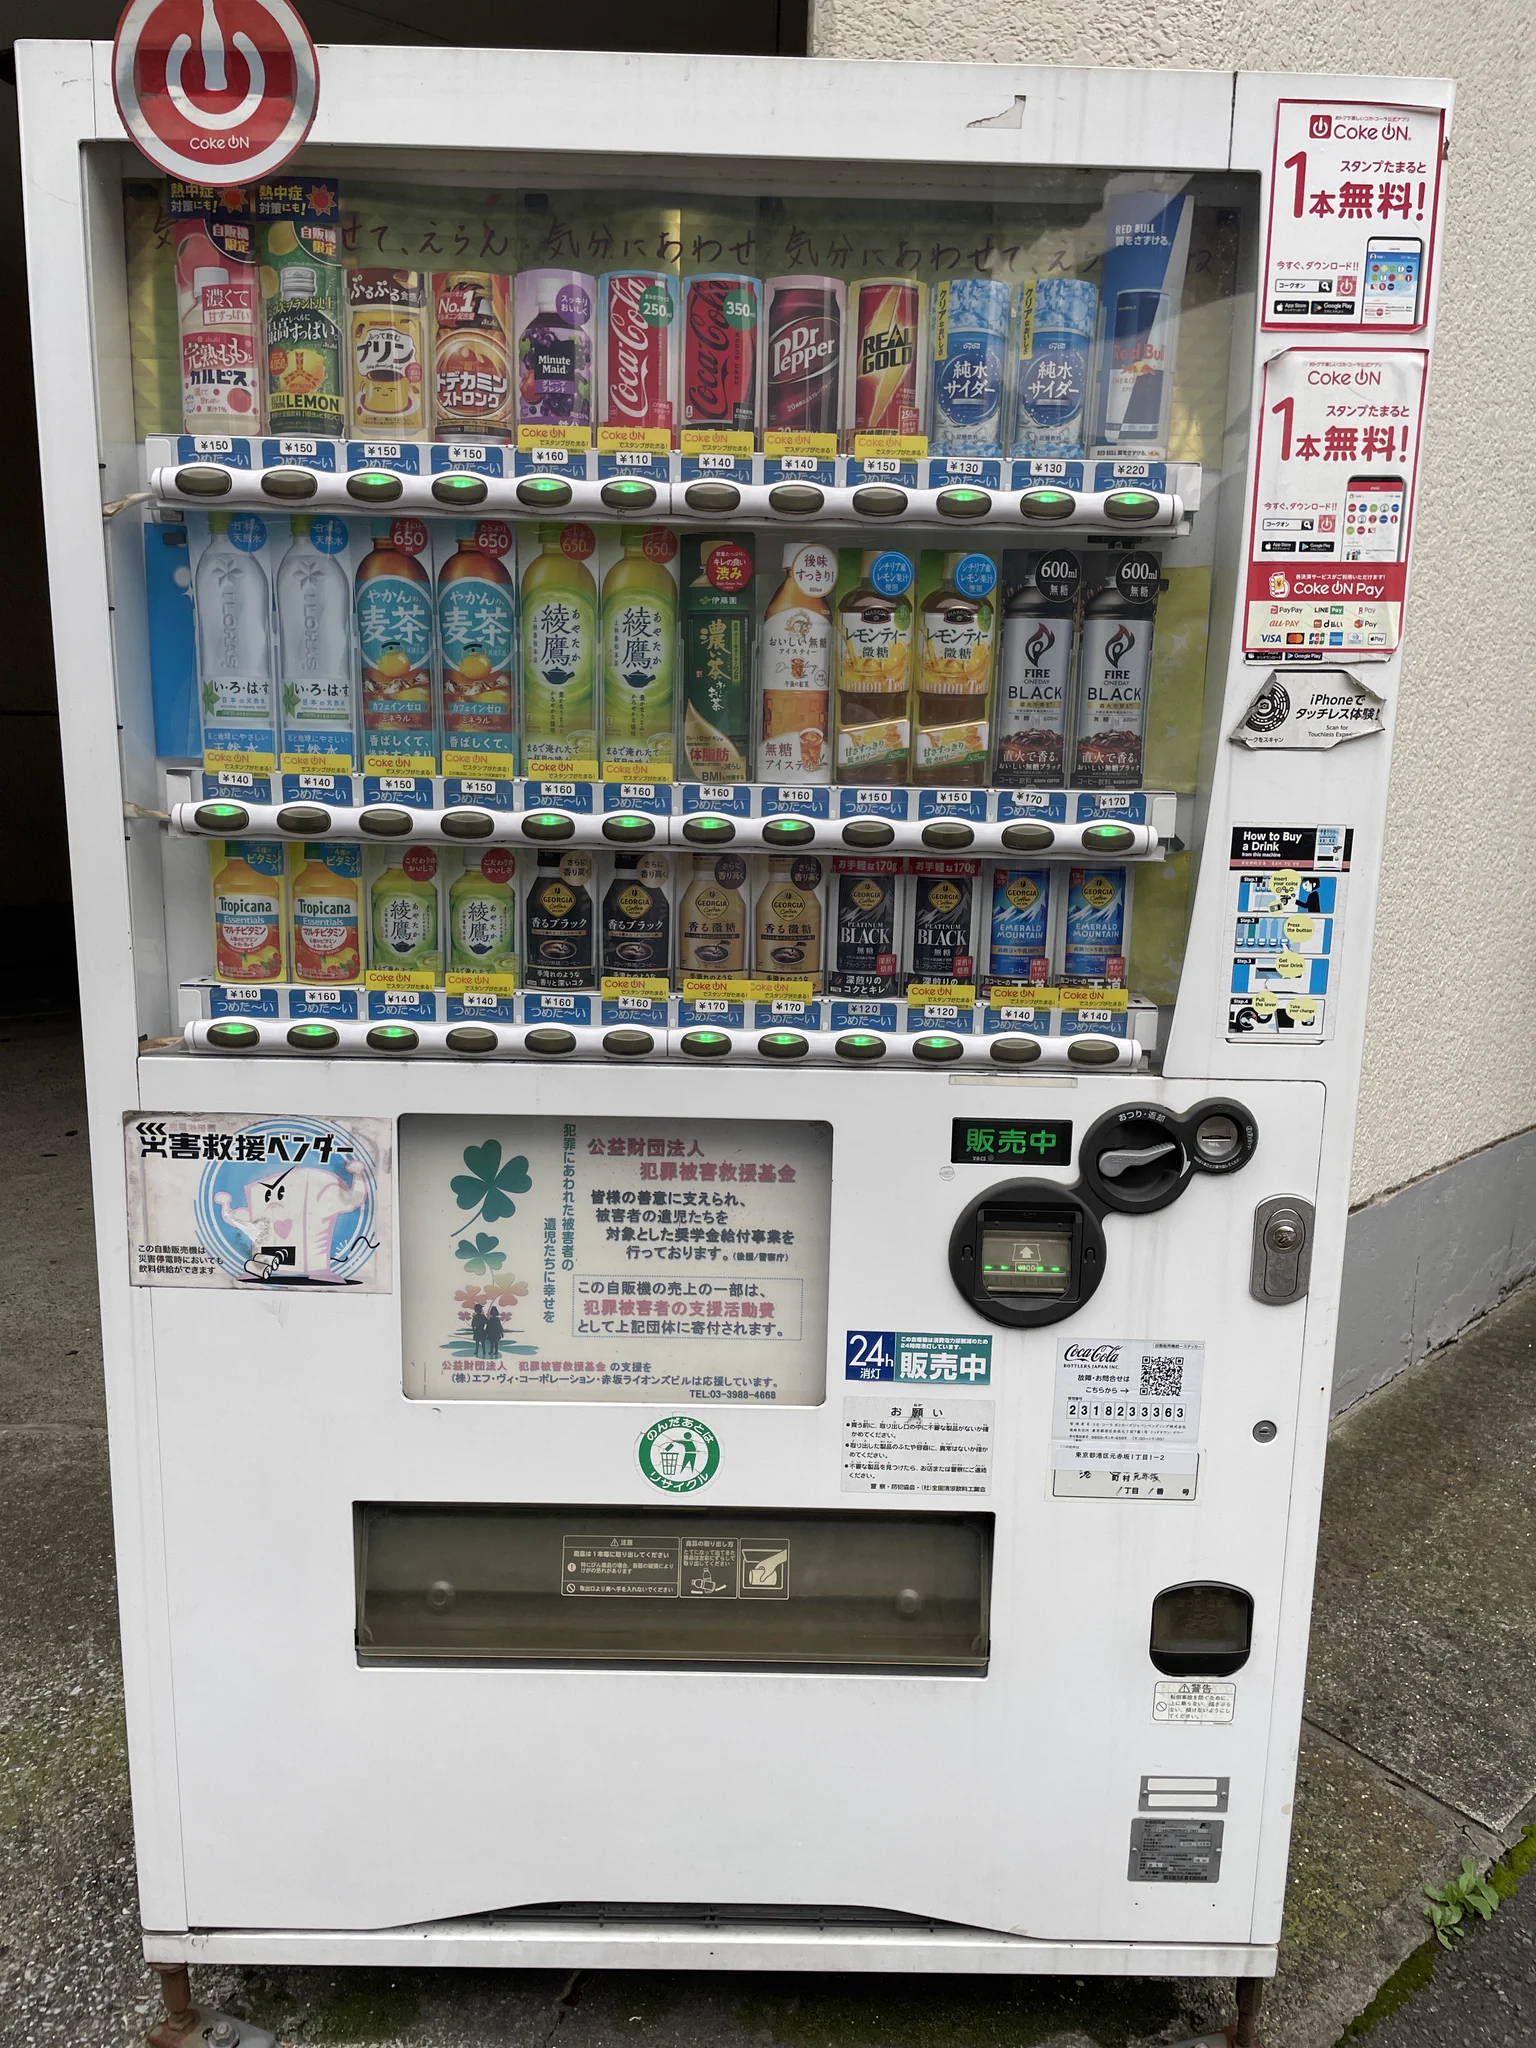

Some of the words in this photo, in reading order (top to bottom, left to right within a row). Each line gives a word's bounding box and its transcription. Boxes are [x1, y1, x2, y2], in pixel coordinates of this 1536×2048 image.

[1334, 125, 1378, 140] Coke
[190, 137, 225, 150] Coke
[1341, 160, 1427, 174] スタンプたまると
[259, 185, 303, 200] 熱中症
[212, 224, 249, 240] 自販機
[300, 225, 336, 243] 自販機
[1115, 224, 1132, 235] RED
[1134, 224, 1155, 234] BULL
[224, 240, 250, 254] 限定
[312, 240, 336, 256] 限定
[206, 288, 249, 308] 濃くて
[792, 326, 820, 345] Dr
[863, 324, 912, 352] REAL
[357, 340, 415, 364] プリン
[773, 338, 836, 377] Pepper
[538, 354, 571, 366] Minute
[862, 349, 913, 375] GOLD
[542, 364, 567, 375] Maid
[953, 361, 988, 378] 純水
[1037, 361, 1072, 378] 純水
[190, 370, 249, 387] カルピス
[437, 373, 508, 392] ドデカミン
[1307, 370, 1351, 386] Coke
[943, 380, 995, 399] サイダー
[1028, 381, 1079, 400] サイダー
[286, 395, 339, 410] LEMON
[1325, 405, 1410, 418] スタンプたまると
[521, 428, 548, 438] Coke
[200, 441, 228, 450] ¥150
[368, 447, 397, 456] ¥150
[453, 449, 482, 458] ¥150
[620, 455, 648, 464] ¥110
[702, 458, 731, 467] ¥140
[867, 462, 896, 471] ¥150
[950, 463, 978, 473] ¥130
[1117, 466, 1145, 475] ¥220
[393, 532, 424, 546] 650
[478, 533, 509, 548] 650
[804, 554, 828, 568] 後味
[716, 566, 743, 580] 渋み
[1041, 562, 1078, 579] 600ml
[1121, 563, 1158, 580] 600ml
[1129, 585, 1149, 598] 無糖
[1293, 582, 1330, 595] Coke
[1356, 582, 1384, 598] Pay
[1279, 606, 1303, 614] PayPay
[1331, 607, 1343, 615] Pay
[360, 605, 430, 643] 麦茶
[443, 607, 511, 645] 麦茶
[845, 627, 907, 646] レモンティー
[926, 628, 988, 646] レモンティー
[1260, 634, 1282, 643] VISA
[863, 646, 889, 659] 微糖
[1024, 668, 1051, 678] FIRE
[1104, 670, 1130, 680] FIRE
[1008, 686, 1062, 700] BLACK
[1088, 687, 1142, 701] BLACK
[1310, 694, 1366, 706] iPhoneで
[689, 747, 729, 762] 体脂肪
[764, 742, 793, 757] 無糖
[222, 774, 249, 784] ¥140
[385, 779, 412, 789] ¥150
[466, 782, 492, 792] ¥150
[624, 786, 651, 796] ¥160
[703, 788, 729, 798] ¥160
[860, 792, 888, 802] ¥150
[940, 793, 968, 802] ¥150
[1101, 797, 1126, 807] ¥170
[1243, 831, 1267, 841] How
[1269, 832, 1280, 841] to
[1282, 832, 1302, 843] Buy
[1242, 843, 1250, 851] a
[1251, 842, 1280, 851] Drink
[1083, 887, 1114, 897] GEORGIA
[218, 897, 272, 914] Tropicana
[298, 898, 351, 916] Tropicana
[543, 896, 574, 905] GEORGIA
[773, 901, 805, 909] GEORGIA
[223, 915, 265, 925] Essentials
[531, 917, 587, 929] 香るブラック
[847, 921, 884, 929] PLATINUM
[1000, 923, 1042, 933] EMERALD
[840, 928, 890, 945] BLACK
[996, 931, 1043, 940] MOUNTAIN
[230, 989, 258, 999] ¥160
[388, 995, 415, 1004] ¥140
[467, 997, 494, 1006] ¥140
[622, 998, 649, 1008] ¥160
[699, 1001, 725, 1011] ¥170
[851, 1005, 878, 1014] ¥120
[928, 1007, 954, 1017] ¥120
[1082, 1011, 1108, 1021] ¥140
[587, 1137, 705, 1158] 公益財団法人
[965, 1128, 1057, 1155] 販売中
[640, 1161, 797, 1183] 犯罪被害救援基金
[561, 1123, 577, 1272] 犯罪にあわれた被害者の
[590, 1189, 746, 1208] 皆様の善意に支えられ、
[595, 1208, 729, 1225] 被害者の遺児たちを
[606, 1227, 795, 1245] 対象とした奨学金給付事業を
[138, 1244, 206, 1255] この自動販売機は
[626, 1245, 730, 1262] 行っております。
[138, 1254, 224, 1265] 災害停電時においても
[138, 1265, 216, 1275] 飲料供給ができます
[543, 1217, 557, 1323] 遺児たちに幸せを
[577, 1280, 766, 1298] この自販機の売上の一部は、
[584, 1299, 776, 1319] 犯罪被害者の支援活動費
[577, 1319, 785, 1338] として上記団体に寄付されます。
[849, 1334, 894, 1367] 24h
[441, 1359, 508, 1372] 公益財団法人
[518, 1360, 607, 1374] 犯罪被害救援基金
[610, 1361, 653, 1374] の支援を
[859, 1367, 881, 1380] 消灯
[900, 1352, 987, 1381] 販売中
[646, 1417, 715, 1444] のんだあとは
[650, 1471, 710, 1492] リサイクル
[1191, 1683, 1212, 1694] 警告
